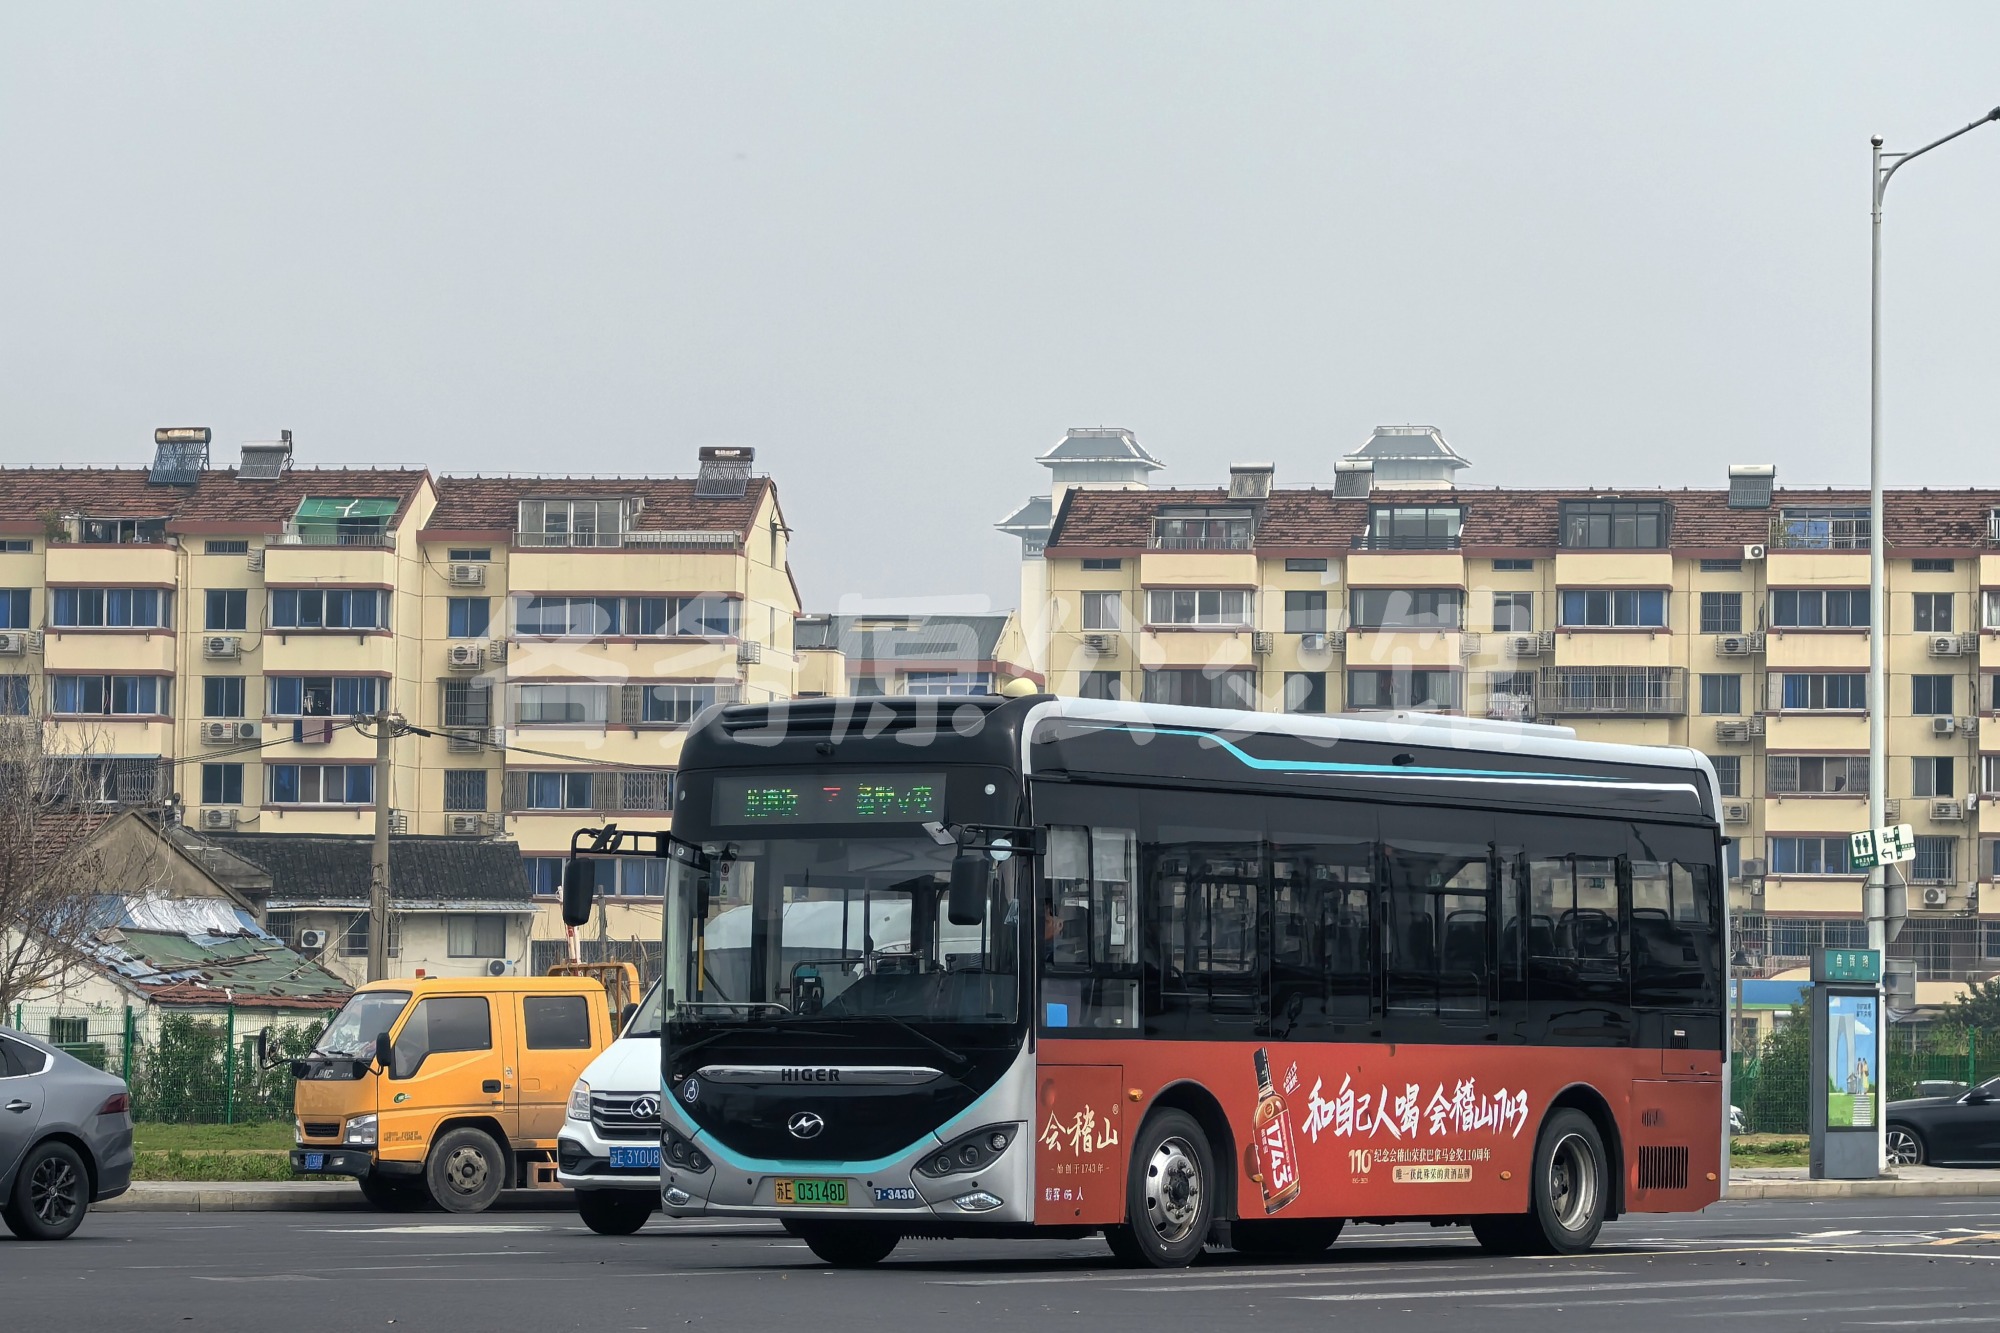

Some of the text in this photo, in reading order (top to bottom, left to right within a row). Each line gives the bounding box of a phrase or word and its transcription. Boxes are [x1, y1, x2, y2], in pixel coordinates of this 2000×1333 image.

[781, 1068, 840, 1081] HIGER
[1038, 1104, 1118, 1157] 会稽山
[1266, 1119, 1289, 1189] 1743
